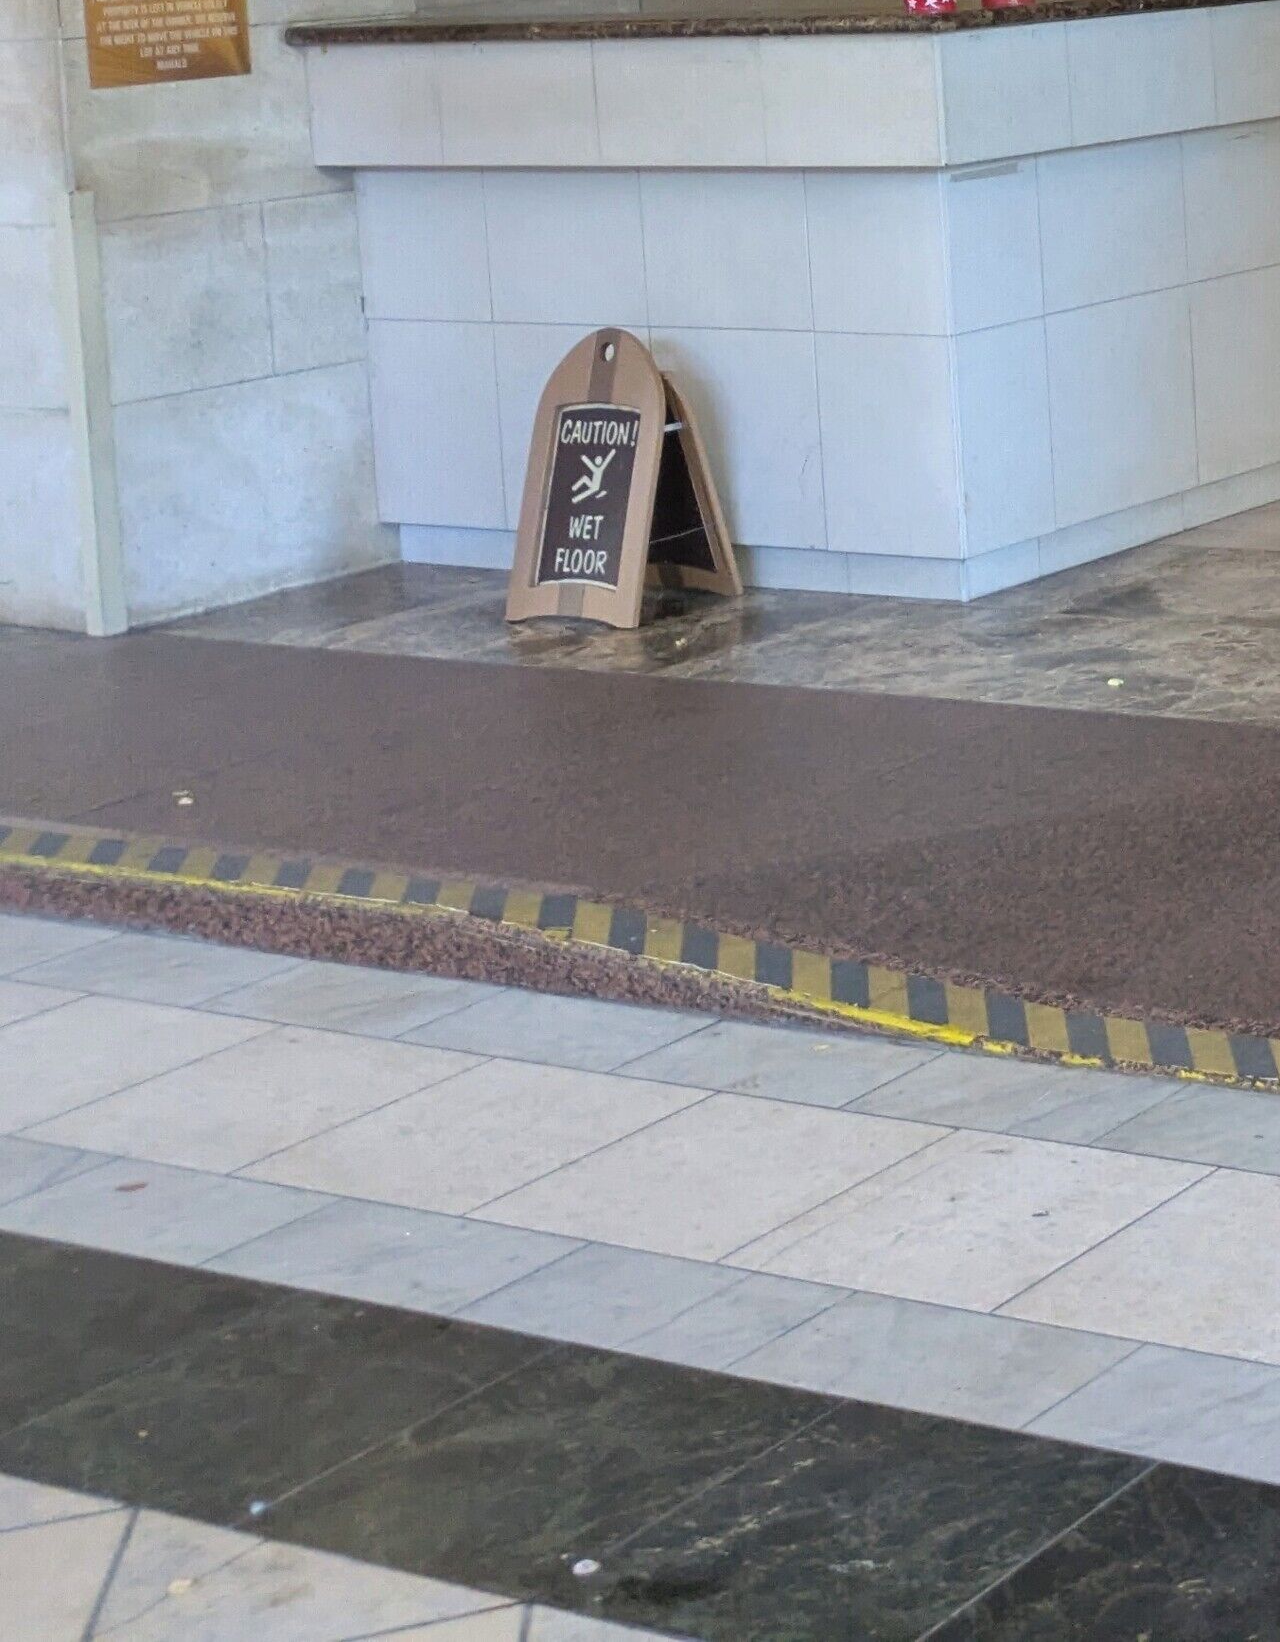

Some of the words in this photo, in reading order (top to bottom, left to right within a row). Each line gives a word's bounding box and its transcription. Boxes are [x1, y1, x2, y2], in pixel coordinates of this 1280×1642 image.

[560, 418, 639, 446] CAUTION!
[569, 514, 604, 540] WET
[554, 547, 607, 575] FLOOR
